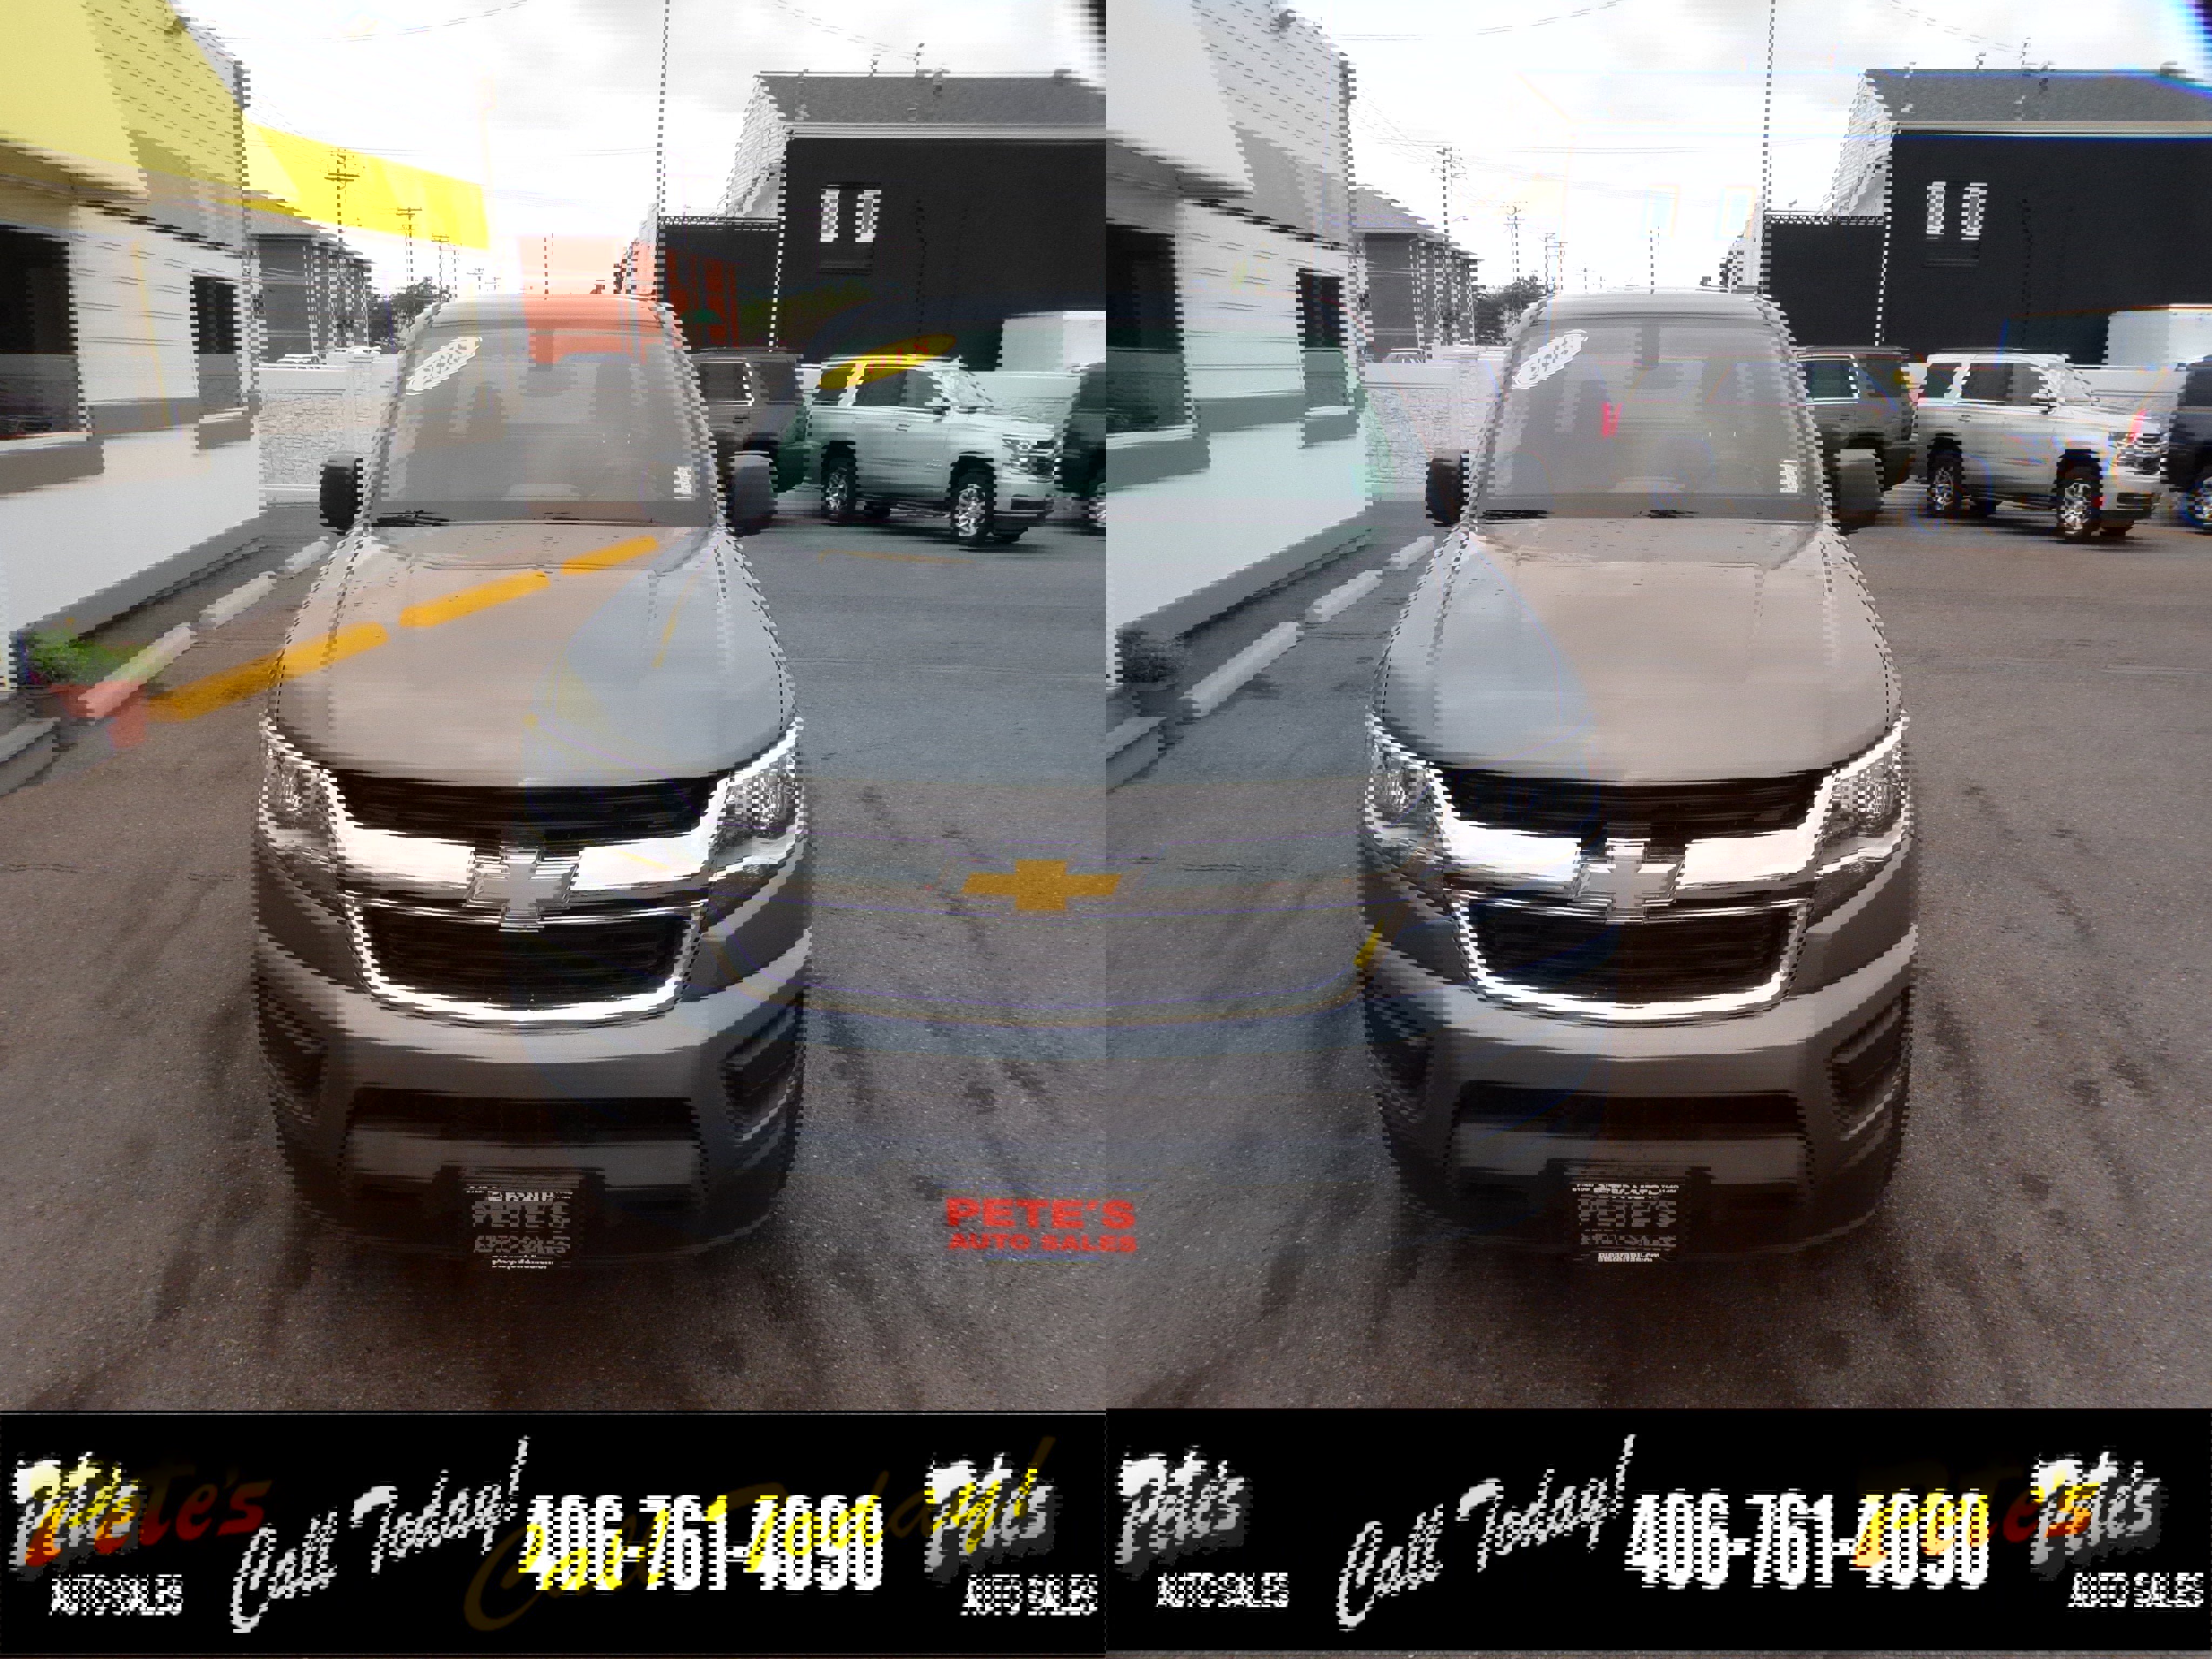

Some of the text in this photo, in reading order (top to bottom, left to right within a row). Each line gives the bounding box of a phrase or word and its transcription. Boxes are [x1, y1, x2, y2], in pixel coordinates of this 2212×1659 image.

[945, 1197, 1136, 1229] PETE'S
[947, 1233, 1138, 1252] AUTO SALES
